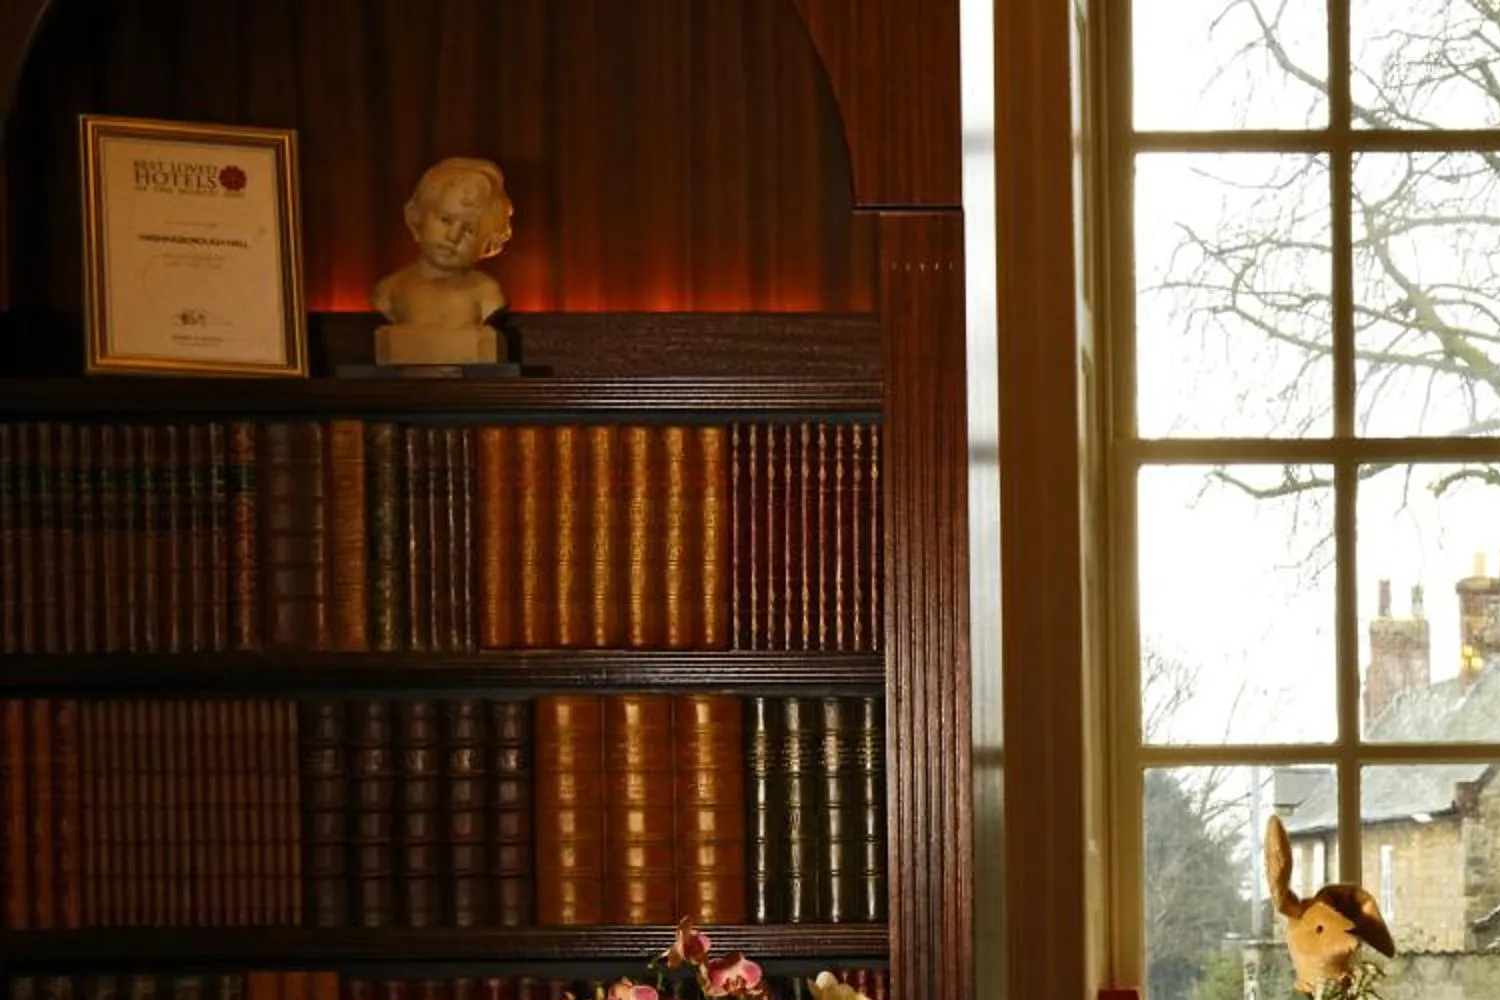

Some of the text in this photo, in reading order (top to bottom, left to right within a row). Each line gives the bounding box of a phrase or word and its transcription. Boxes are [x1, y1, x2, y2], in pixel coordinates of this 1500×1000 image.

[133, 161, 218, 175] BEST LOVED
[134, 170, 218, 189] HOTELS
